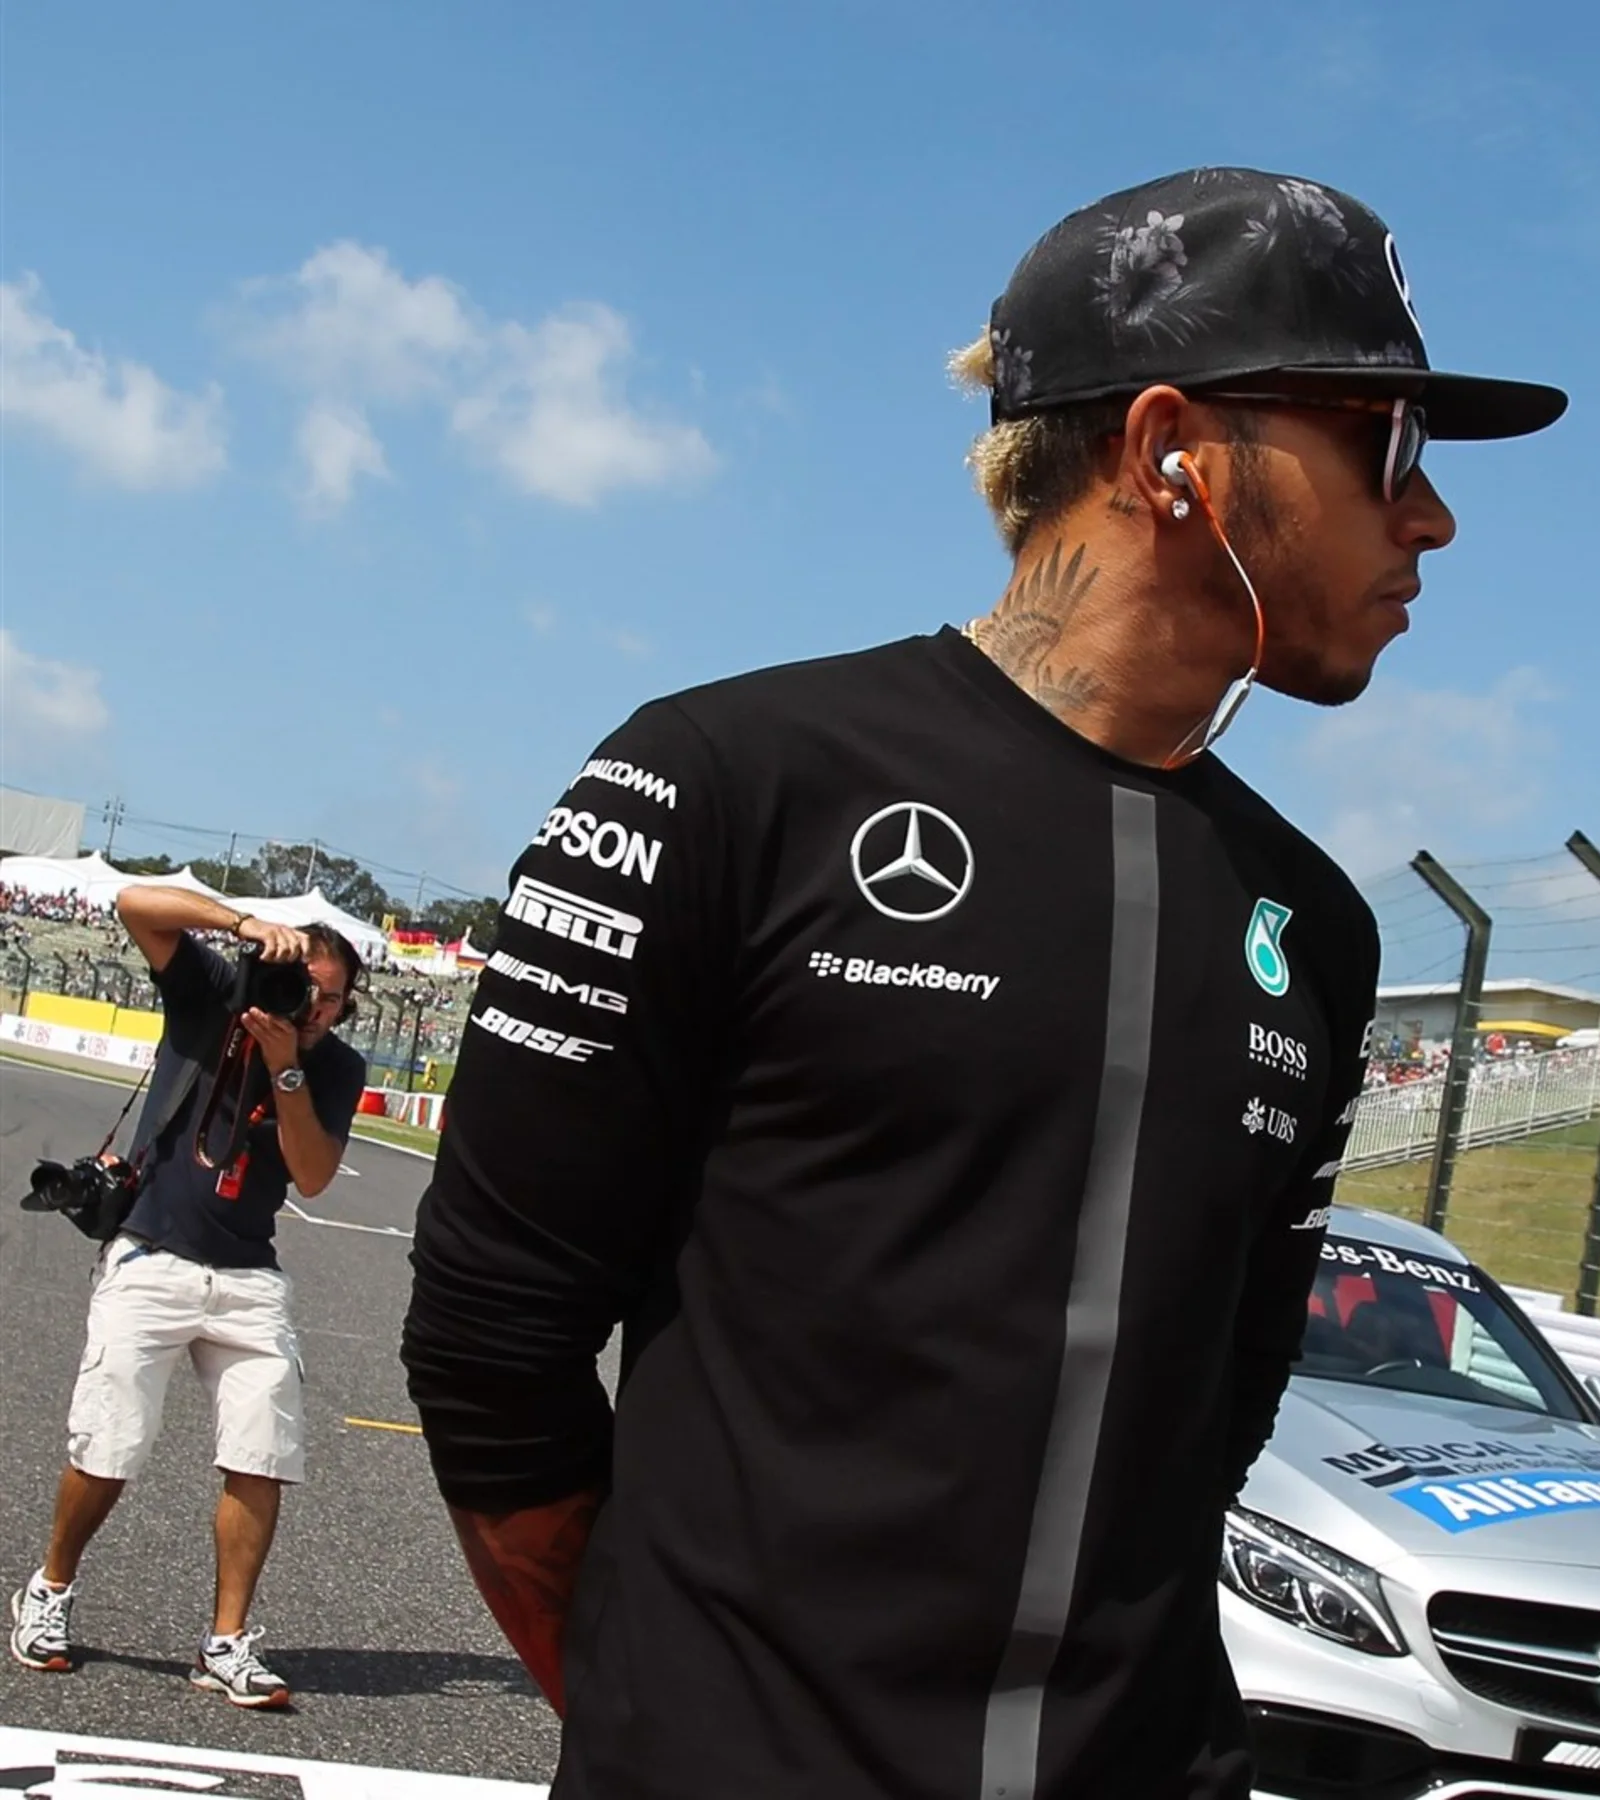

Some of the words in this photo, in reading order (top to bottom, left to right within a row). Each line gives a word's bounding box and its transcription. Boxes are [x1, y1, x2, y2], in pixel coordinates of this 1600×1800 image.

[531, 806, 663, 885] EPSON
[505, 874, 645, 960] PIRELLI
[516, 964, 629, 1015] AMG
[844, 957, 1000, 1000] BlackBerry
[470, 1006, 614, 1063] BOSE
[1248, 1021, 1307, 1070] BOSS
[1267, 1106, 1298, 1144] UBS
[1321, 1440, 1541, 1476] MEDICAL
